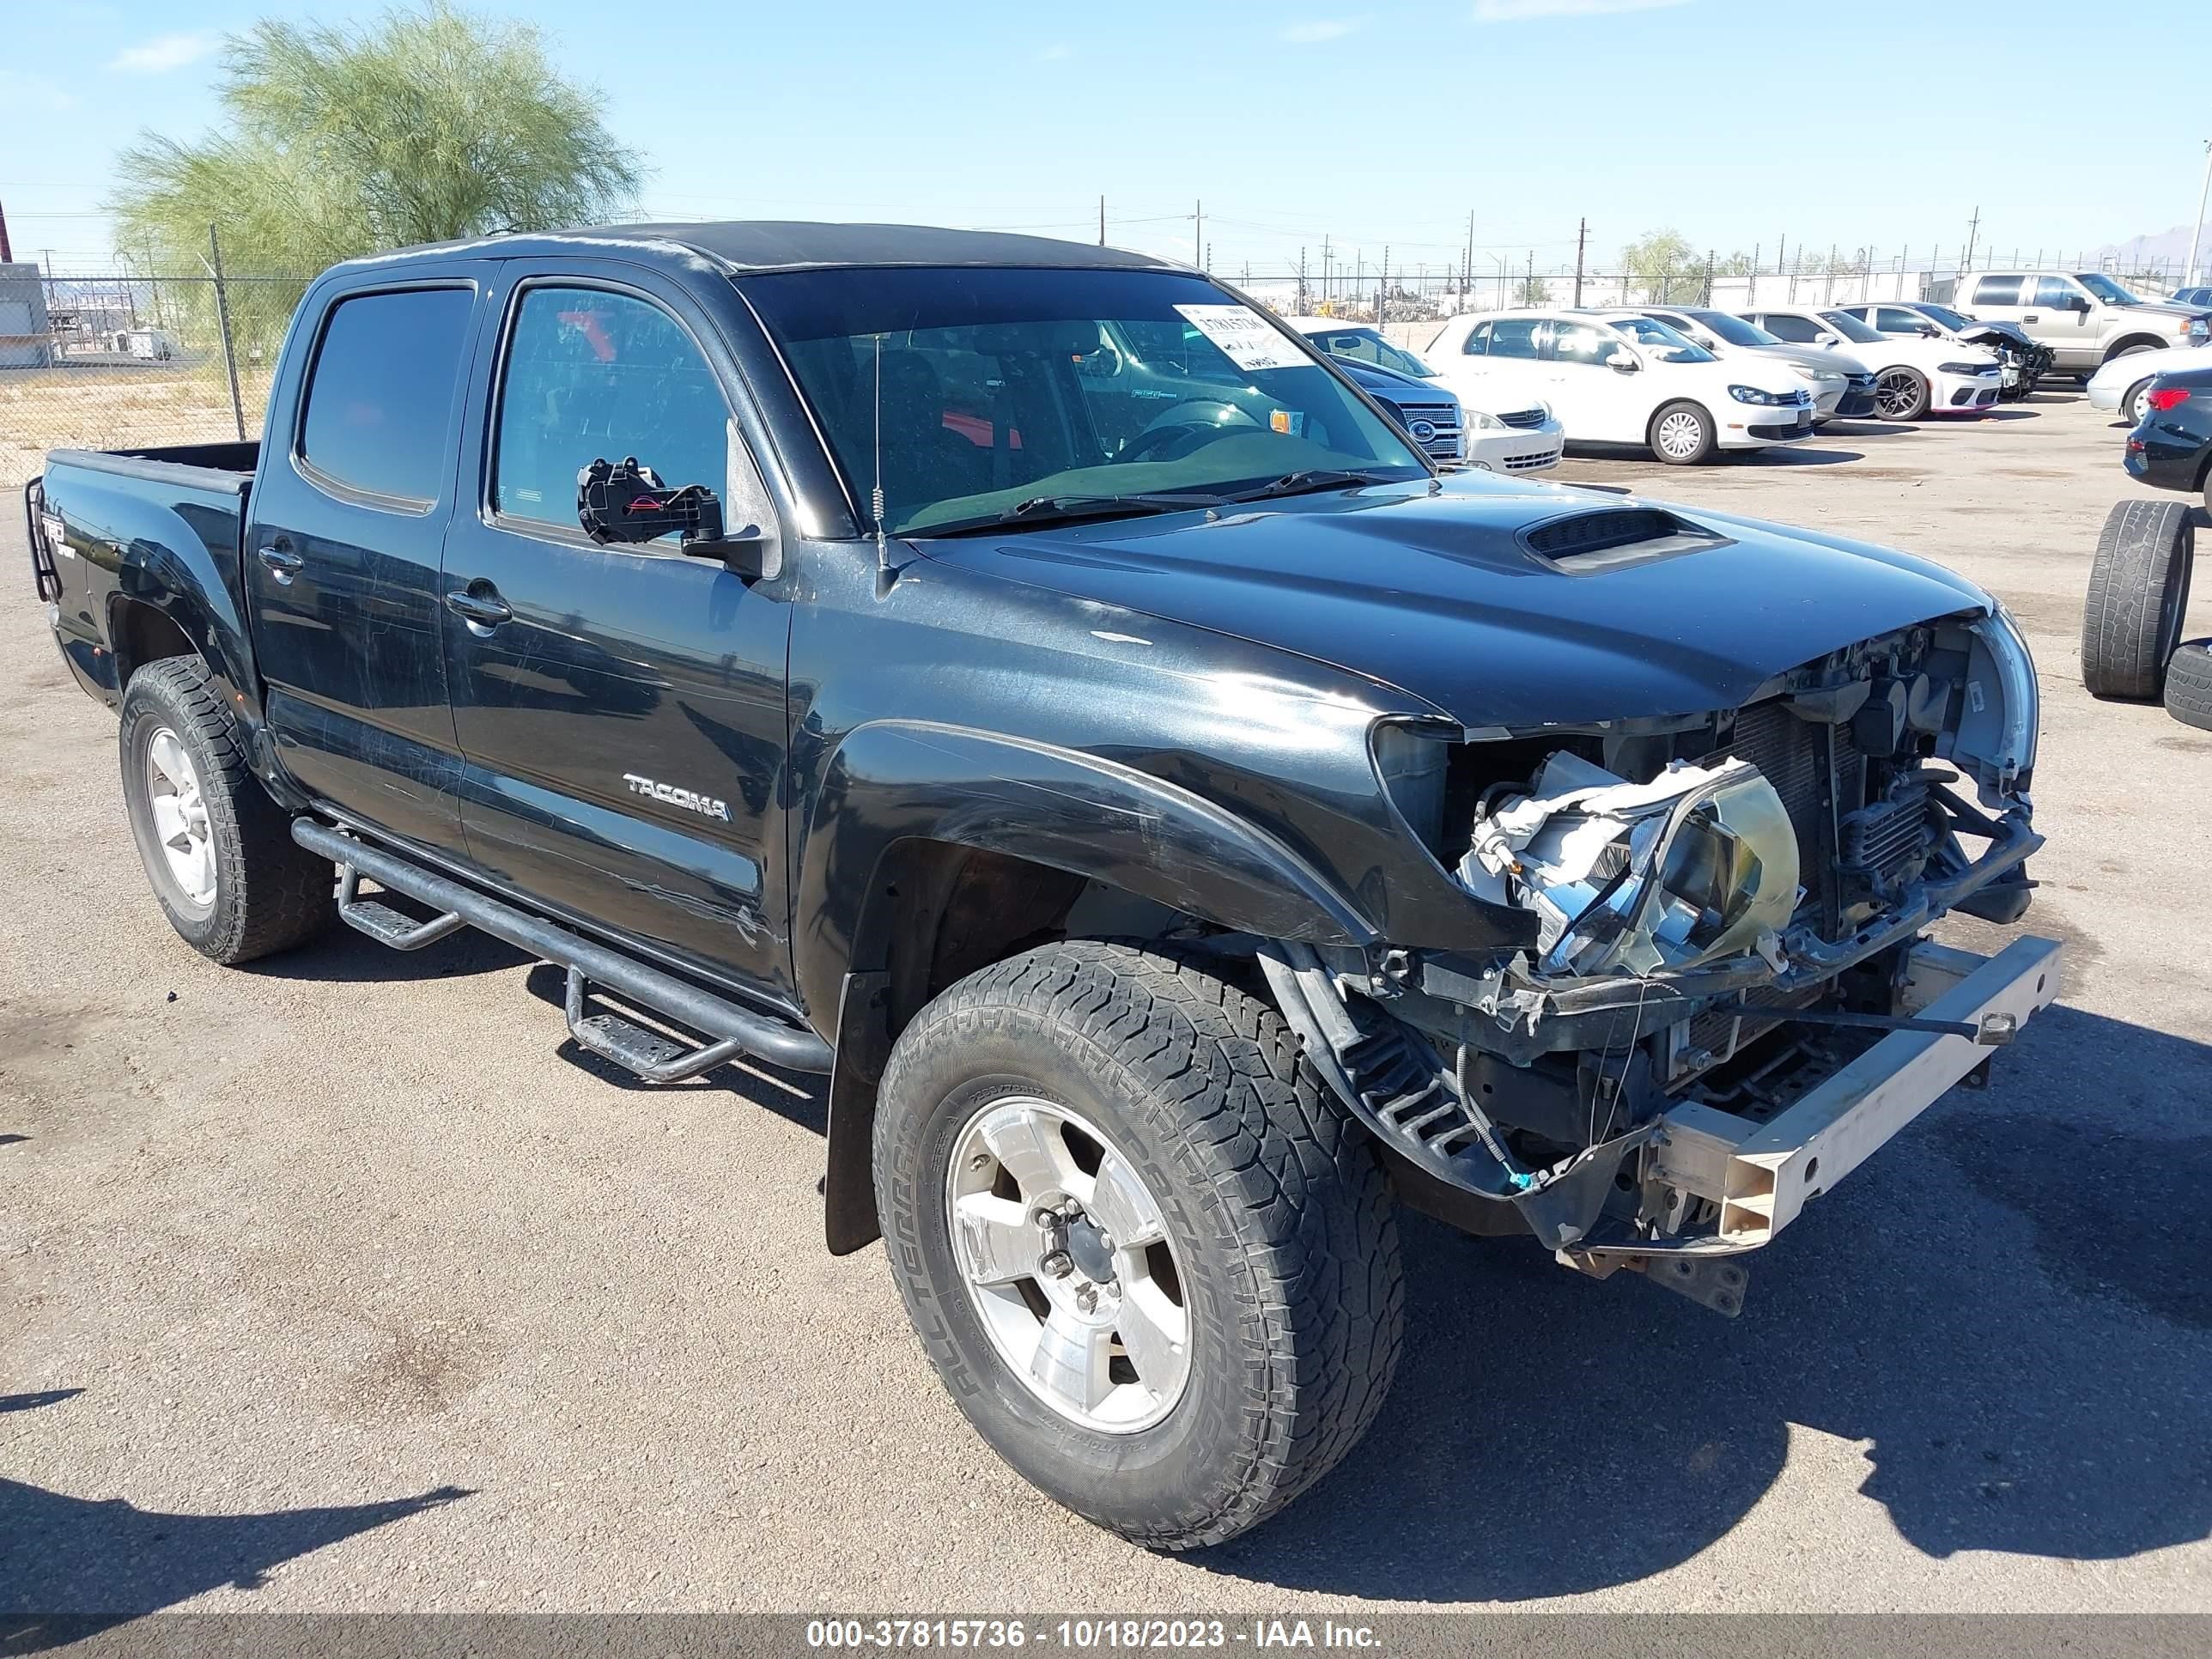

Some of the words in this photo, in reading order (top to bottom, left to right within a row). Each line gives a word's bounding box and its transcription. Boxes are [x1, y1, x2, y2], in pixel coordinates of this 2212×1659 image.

[1199, 316, 1265, 331] 37815736
[623, 773, 734, 824] TACOMA
[892, 1108, 933, 1307] TERRAIN
[1117, 1127, 1227, 1467] PATHFINDER
[929, 1315, 981, 1397] ALL
